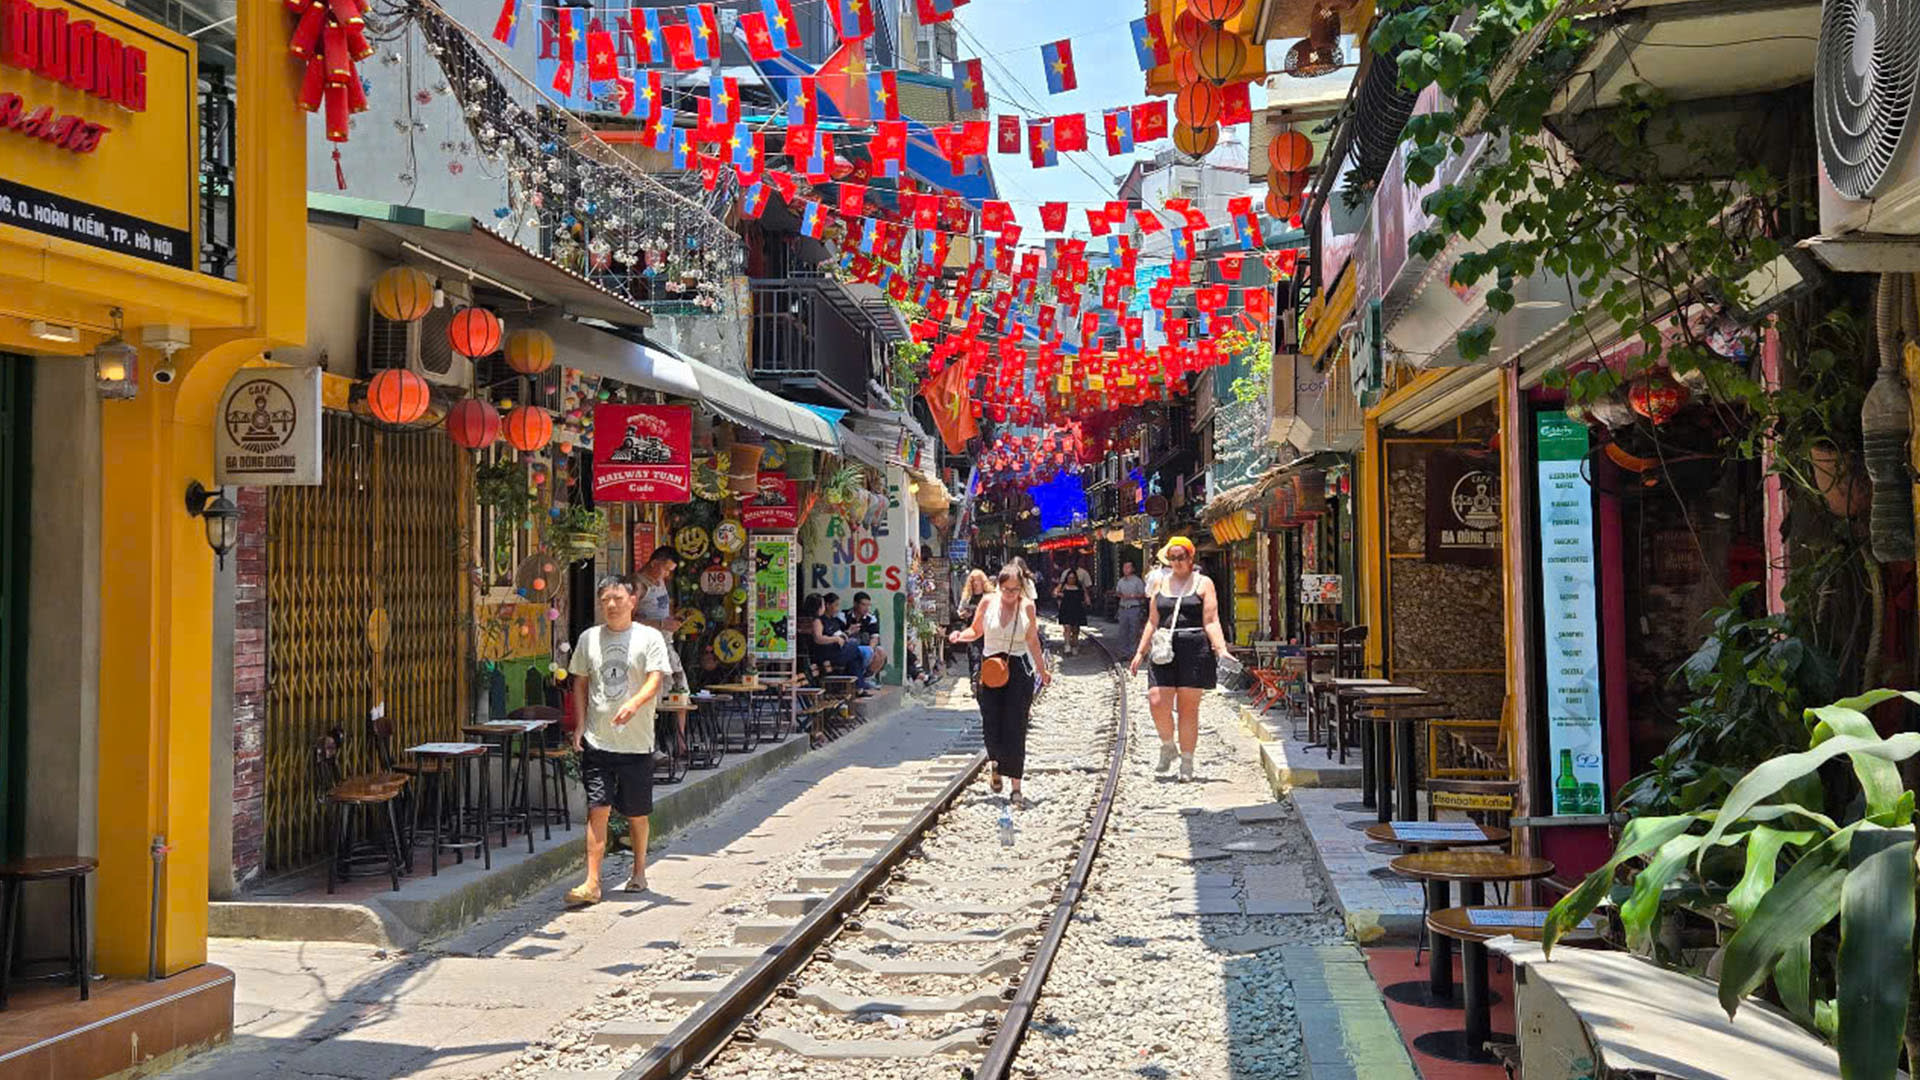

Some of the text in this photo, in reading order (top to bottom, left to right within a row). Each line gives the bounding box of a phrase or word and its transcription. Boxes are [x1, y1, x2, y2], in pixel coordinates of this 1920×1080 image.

[34, 203, 69, 230] HOÀN
[111, 227, 131, 246] TP.
[135, 229, 150, 251] HÀ
[154, 237, 173, 260] NỘI
[597, 470, 683, 485] RAILWAY TUAN
[833, 535, 879, 565] NO
[811, 563, 902, 592] RULES
